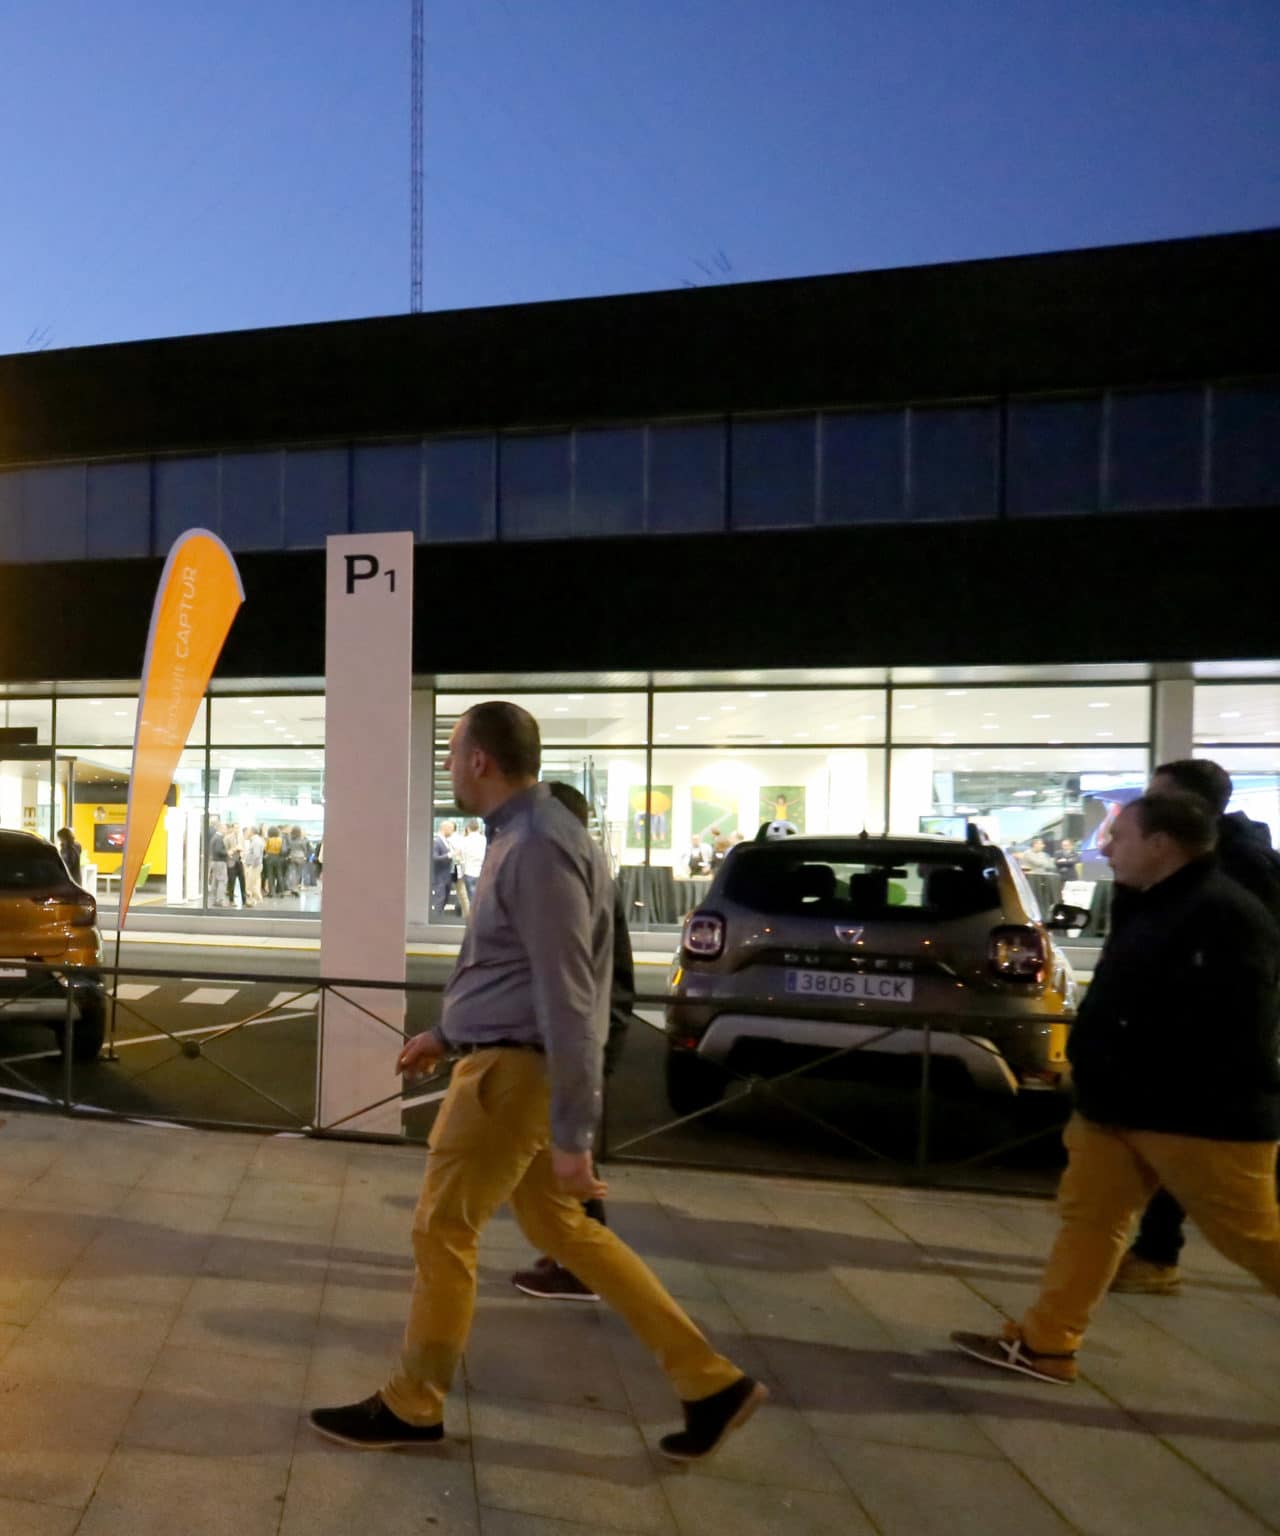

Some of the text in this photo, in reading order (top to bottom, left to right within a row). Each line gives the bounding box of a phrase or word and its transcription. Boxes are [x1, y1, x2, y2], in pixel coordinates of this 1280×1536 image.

[176, 567, 197, 657] CAPTUR
[784, 953, 913, 970] DUTER
[801, 973, 908, 997] 3806 LCK
